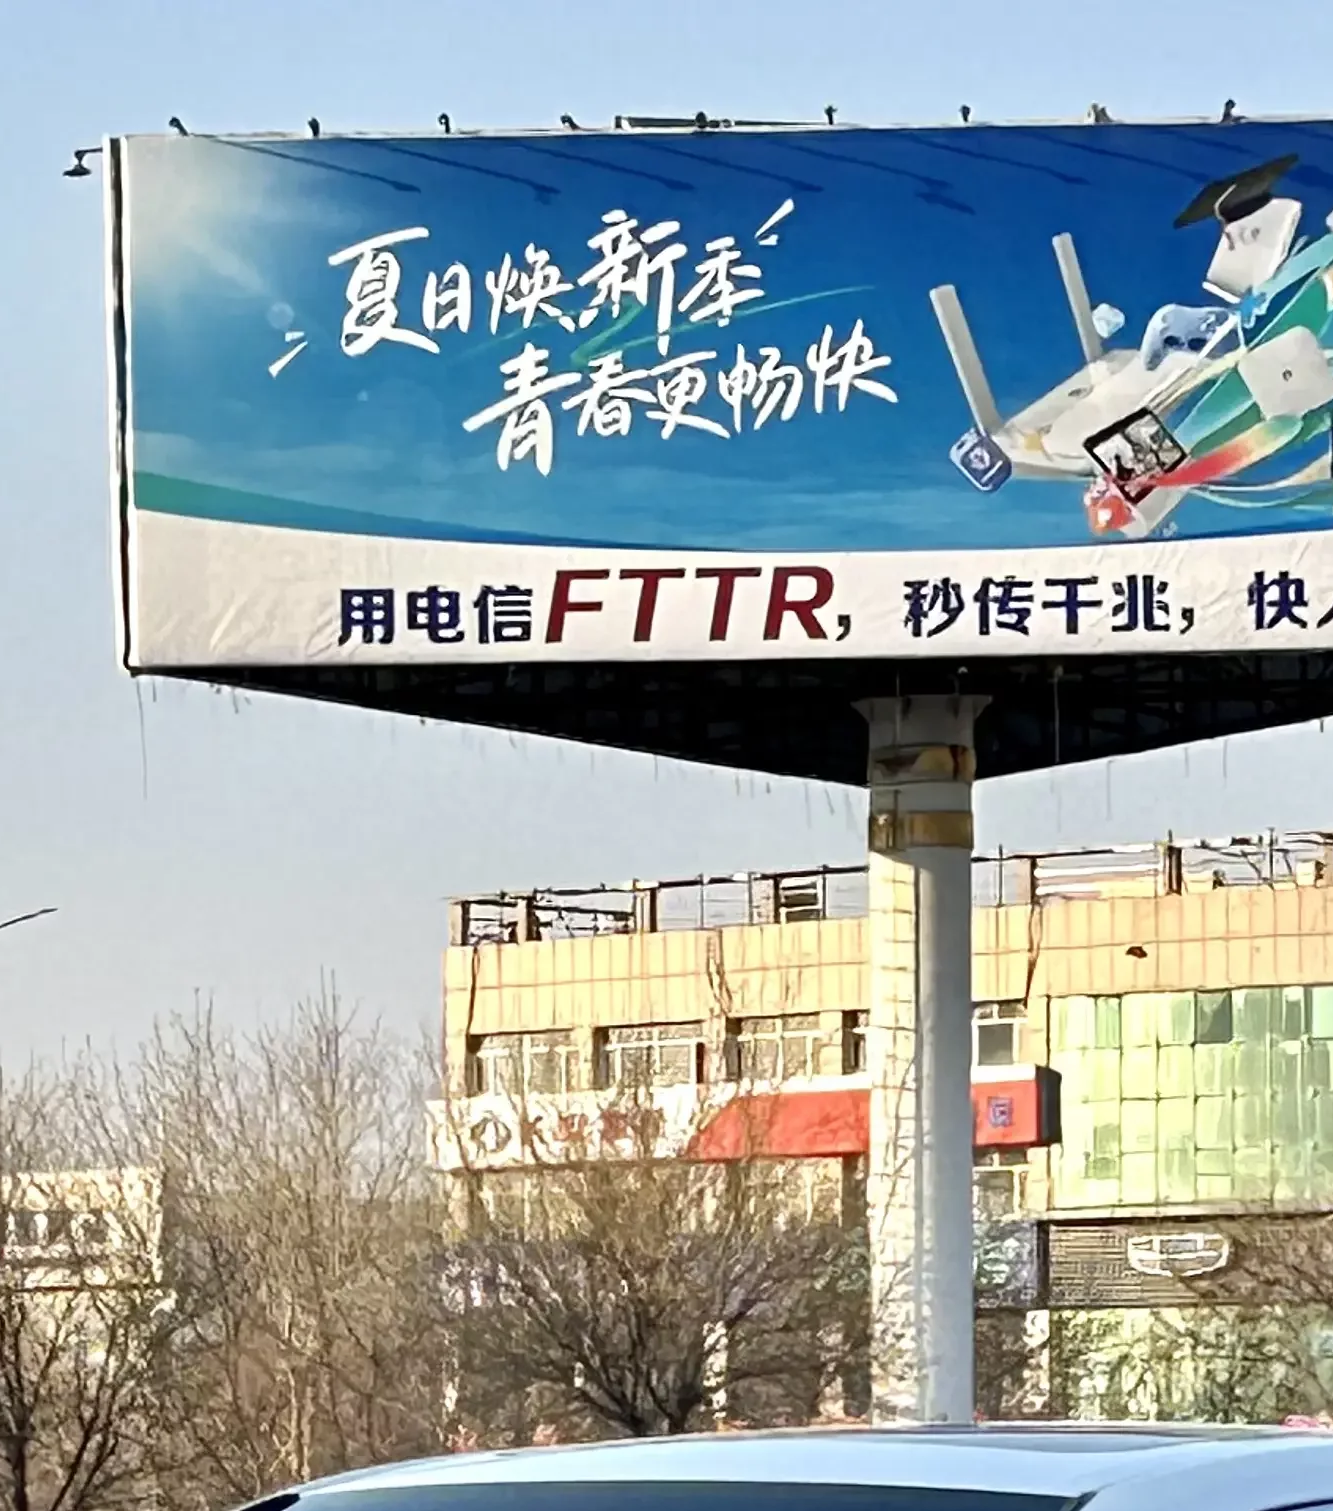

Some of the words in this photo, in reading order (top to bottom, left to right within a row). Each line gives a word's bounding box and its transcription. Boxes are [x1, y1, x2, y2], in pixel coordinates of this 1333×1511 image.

[328, 209, 766, 356] 夏日焕新季
[463, 318, 899, 477] 青春更畅快
